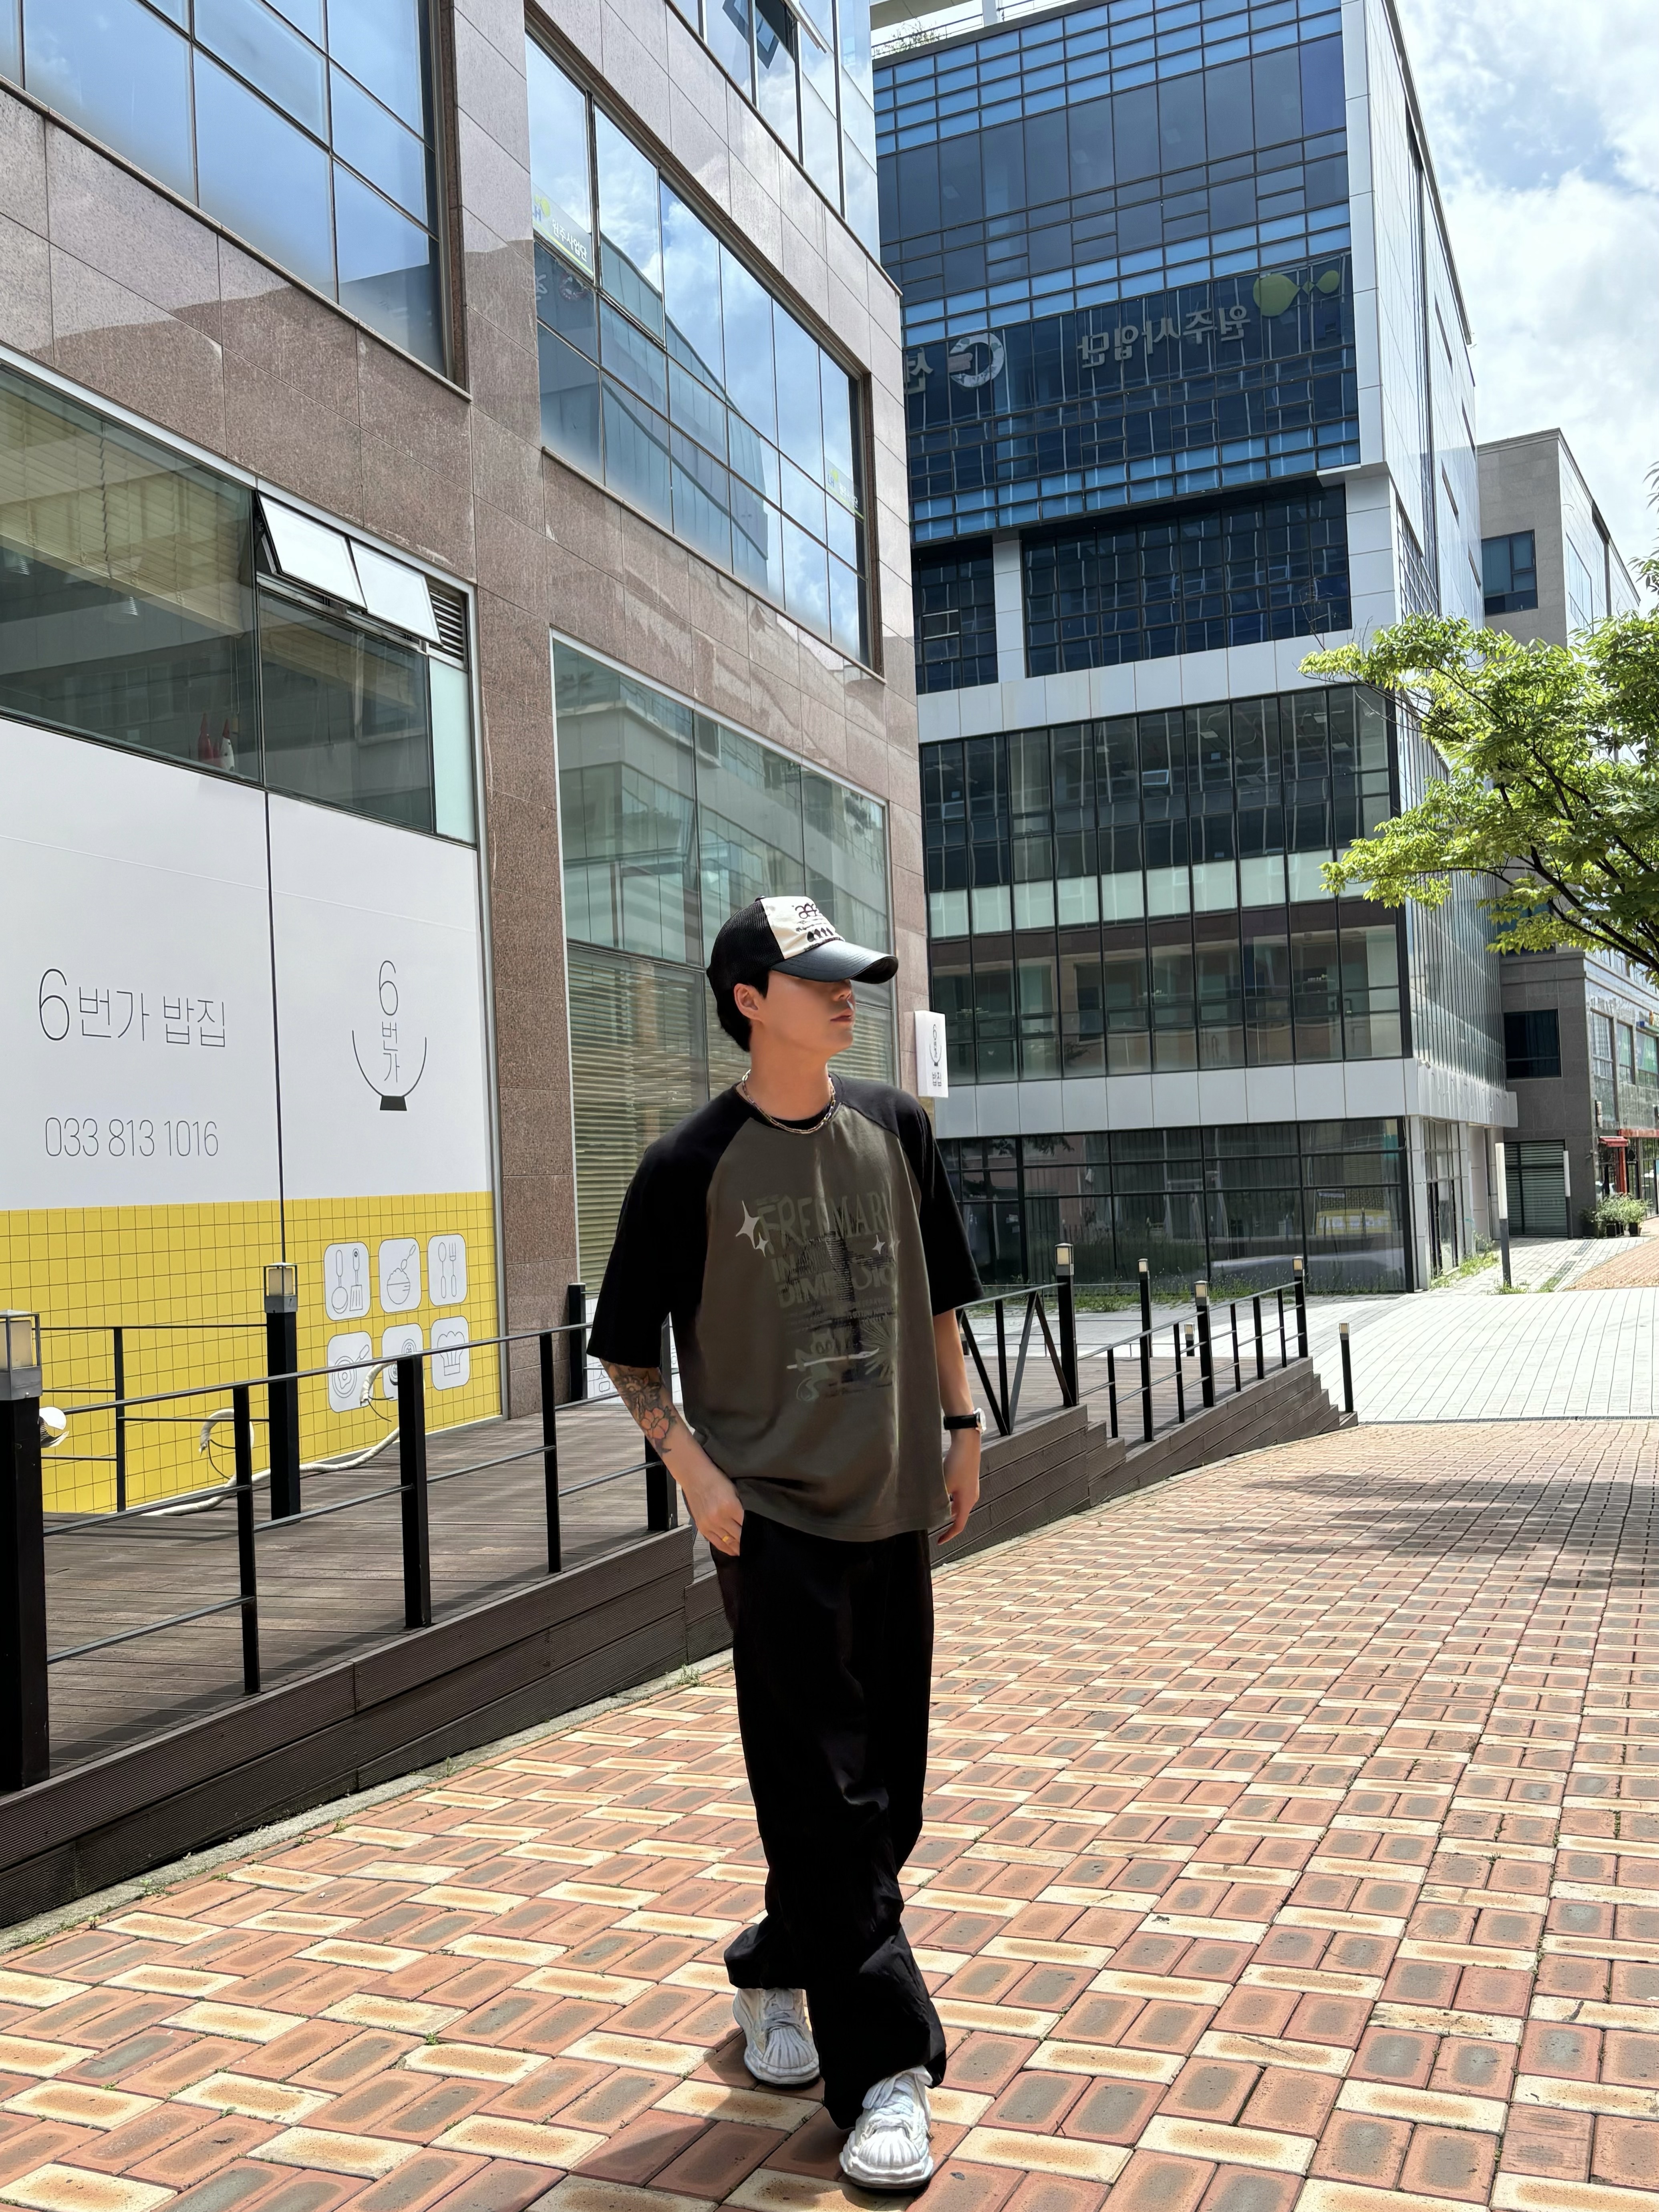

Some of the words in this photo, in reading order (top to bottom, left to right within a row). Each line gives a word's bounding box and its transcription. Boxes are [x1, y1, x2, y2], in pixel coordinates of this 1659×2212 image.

[552, 219, 587, 262] 원주사업단
[40, 968, 149, 1041] 6번가
[163, 996, 225, 1047] 밥집
[45, 1117, 99, 1156] 033
[109, 1119, 155, 1156] 813
[164, 1120, 218, 1156] 1016
